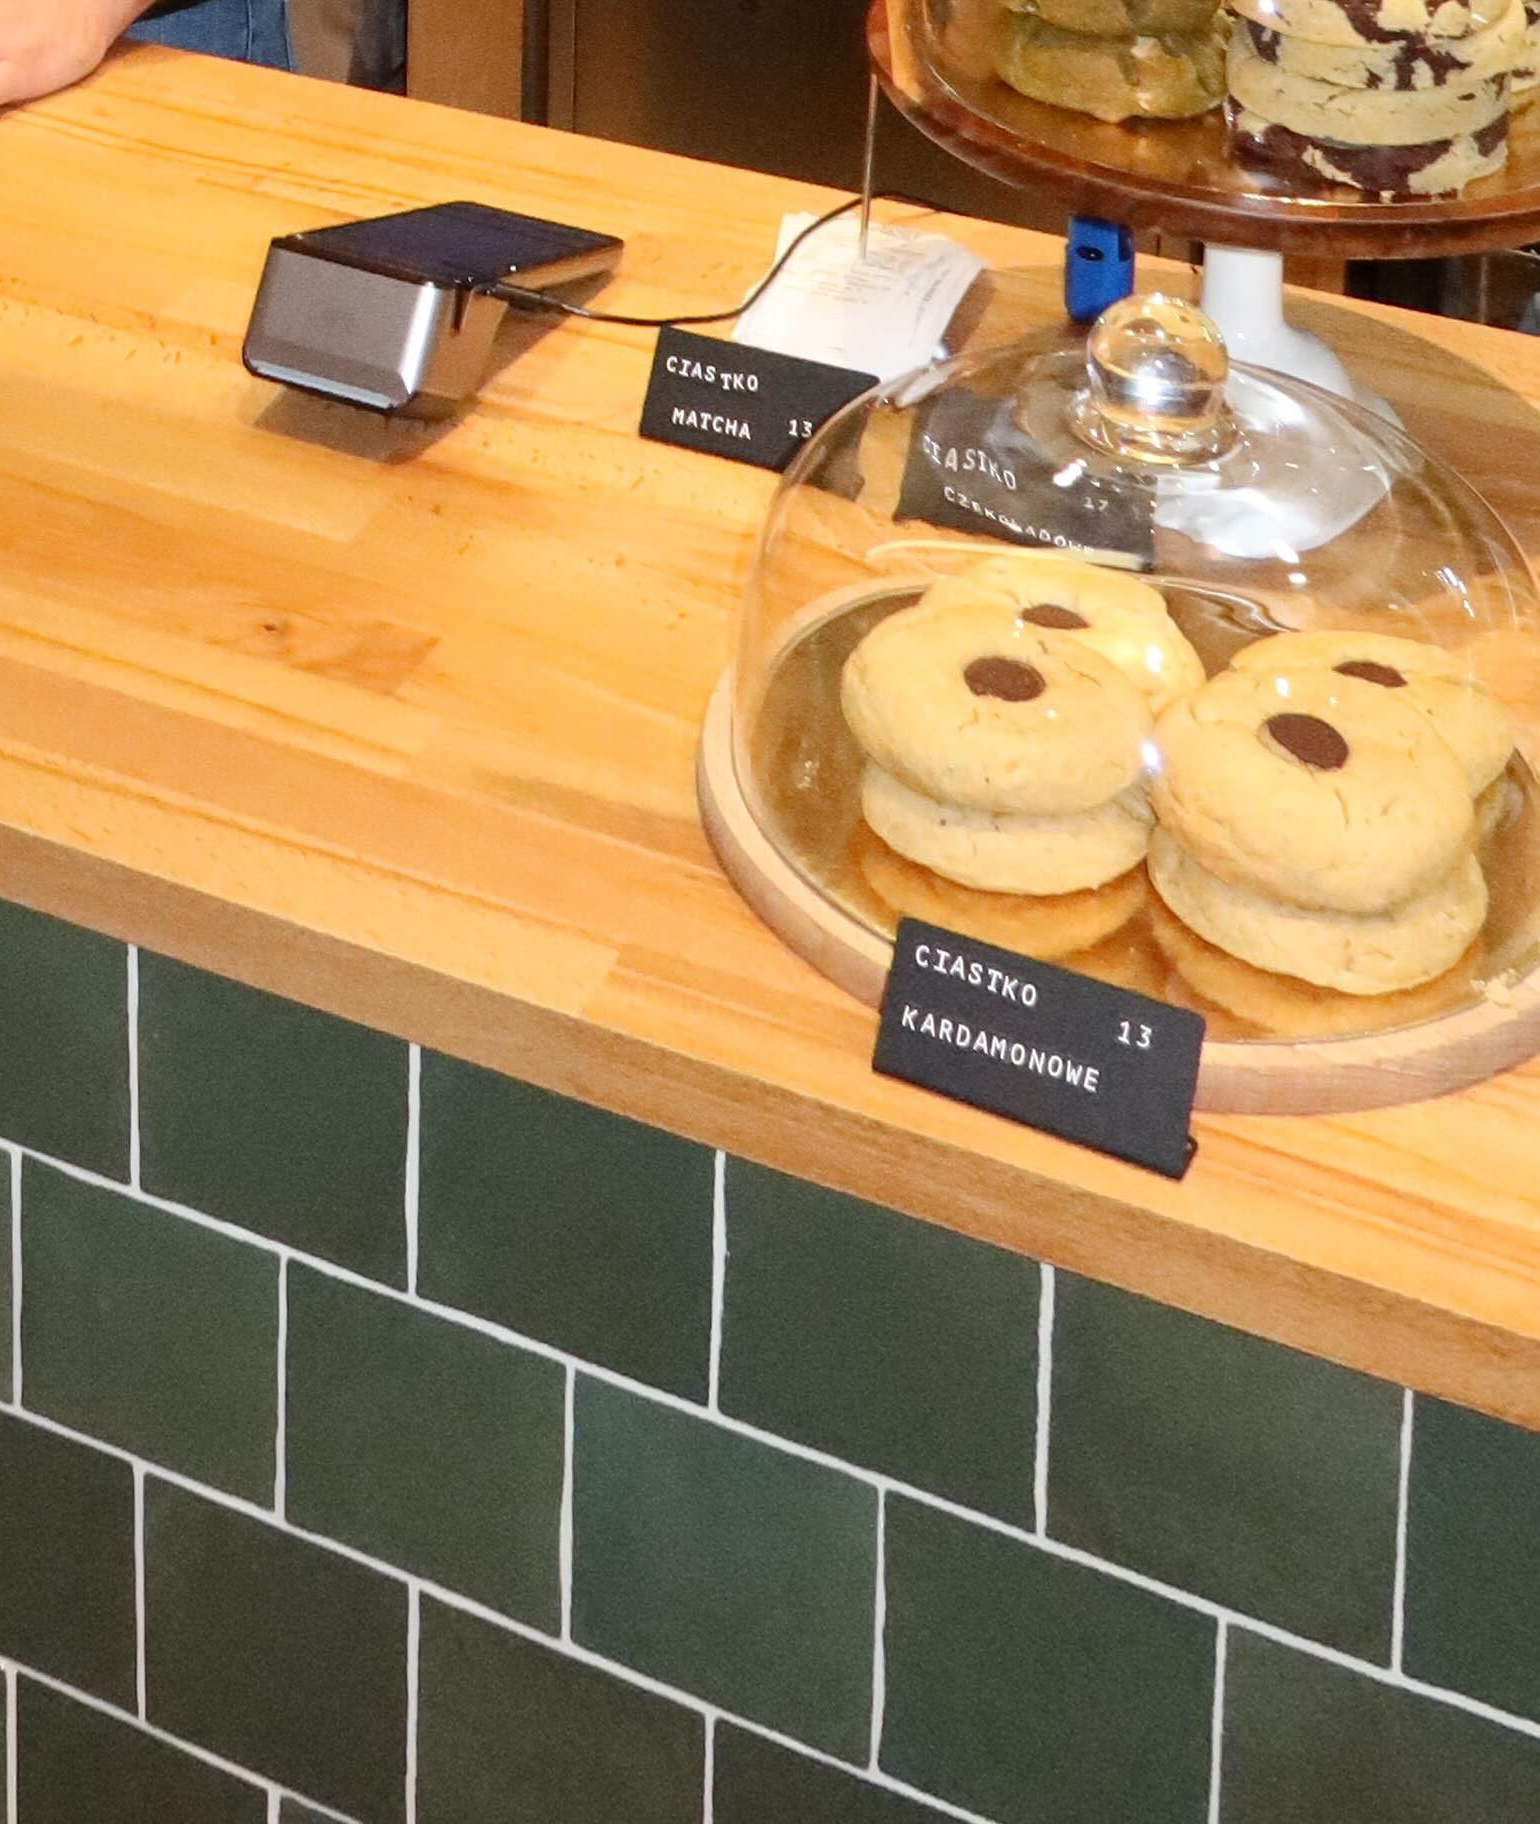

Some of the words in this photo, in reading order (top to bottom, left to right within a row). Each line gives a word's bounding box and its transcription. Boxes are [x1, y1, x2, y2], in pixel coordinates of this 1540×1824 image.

[666, 355, 759, 393] CIASTKO
[671, 407, 752, 441] MATCHA
[788, 418, 813, 438] 13
[923, 435, 1017, 491] CIASTKO
[914, 944, 1038, 1008] CIASTKO
[1117, 1020, 1153, 1049] 13
[901, 1004, 1101, 1094] KARDAMONOWE
